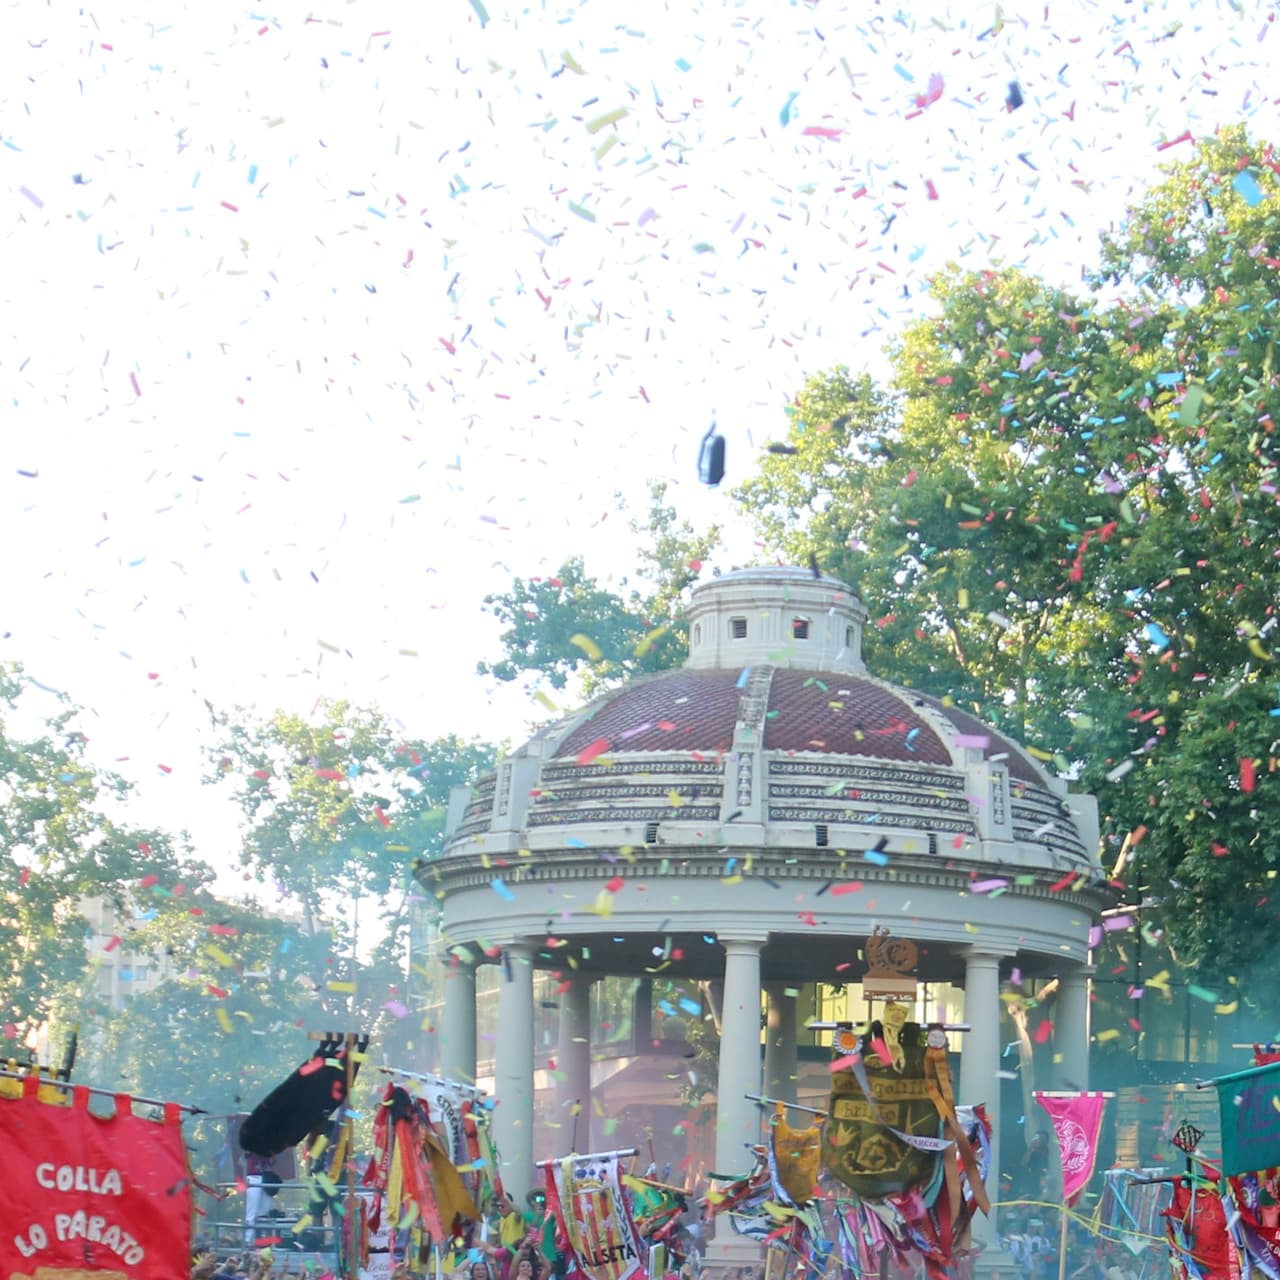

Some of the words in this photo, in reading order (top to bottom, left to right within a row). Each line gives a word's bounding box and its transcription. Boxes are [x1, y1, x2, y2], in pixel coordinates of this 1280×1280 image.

[36, 1161, 123, 1196] COLLA
[14, 1223, 49, 1258] LO
[54, 1209, 145, 1266] PARATO
